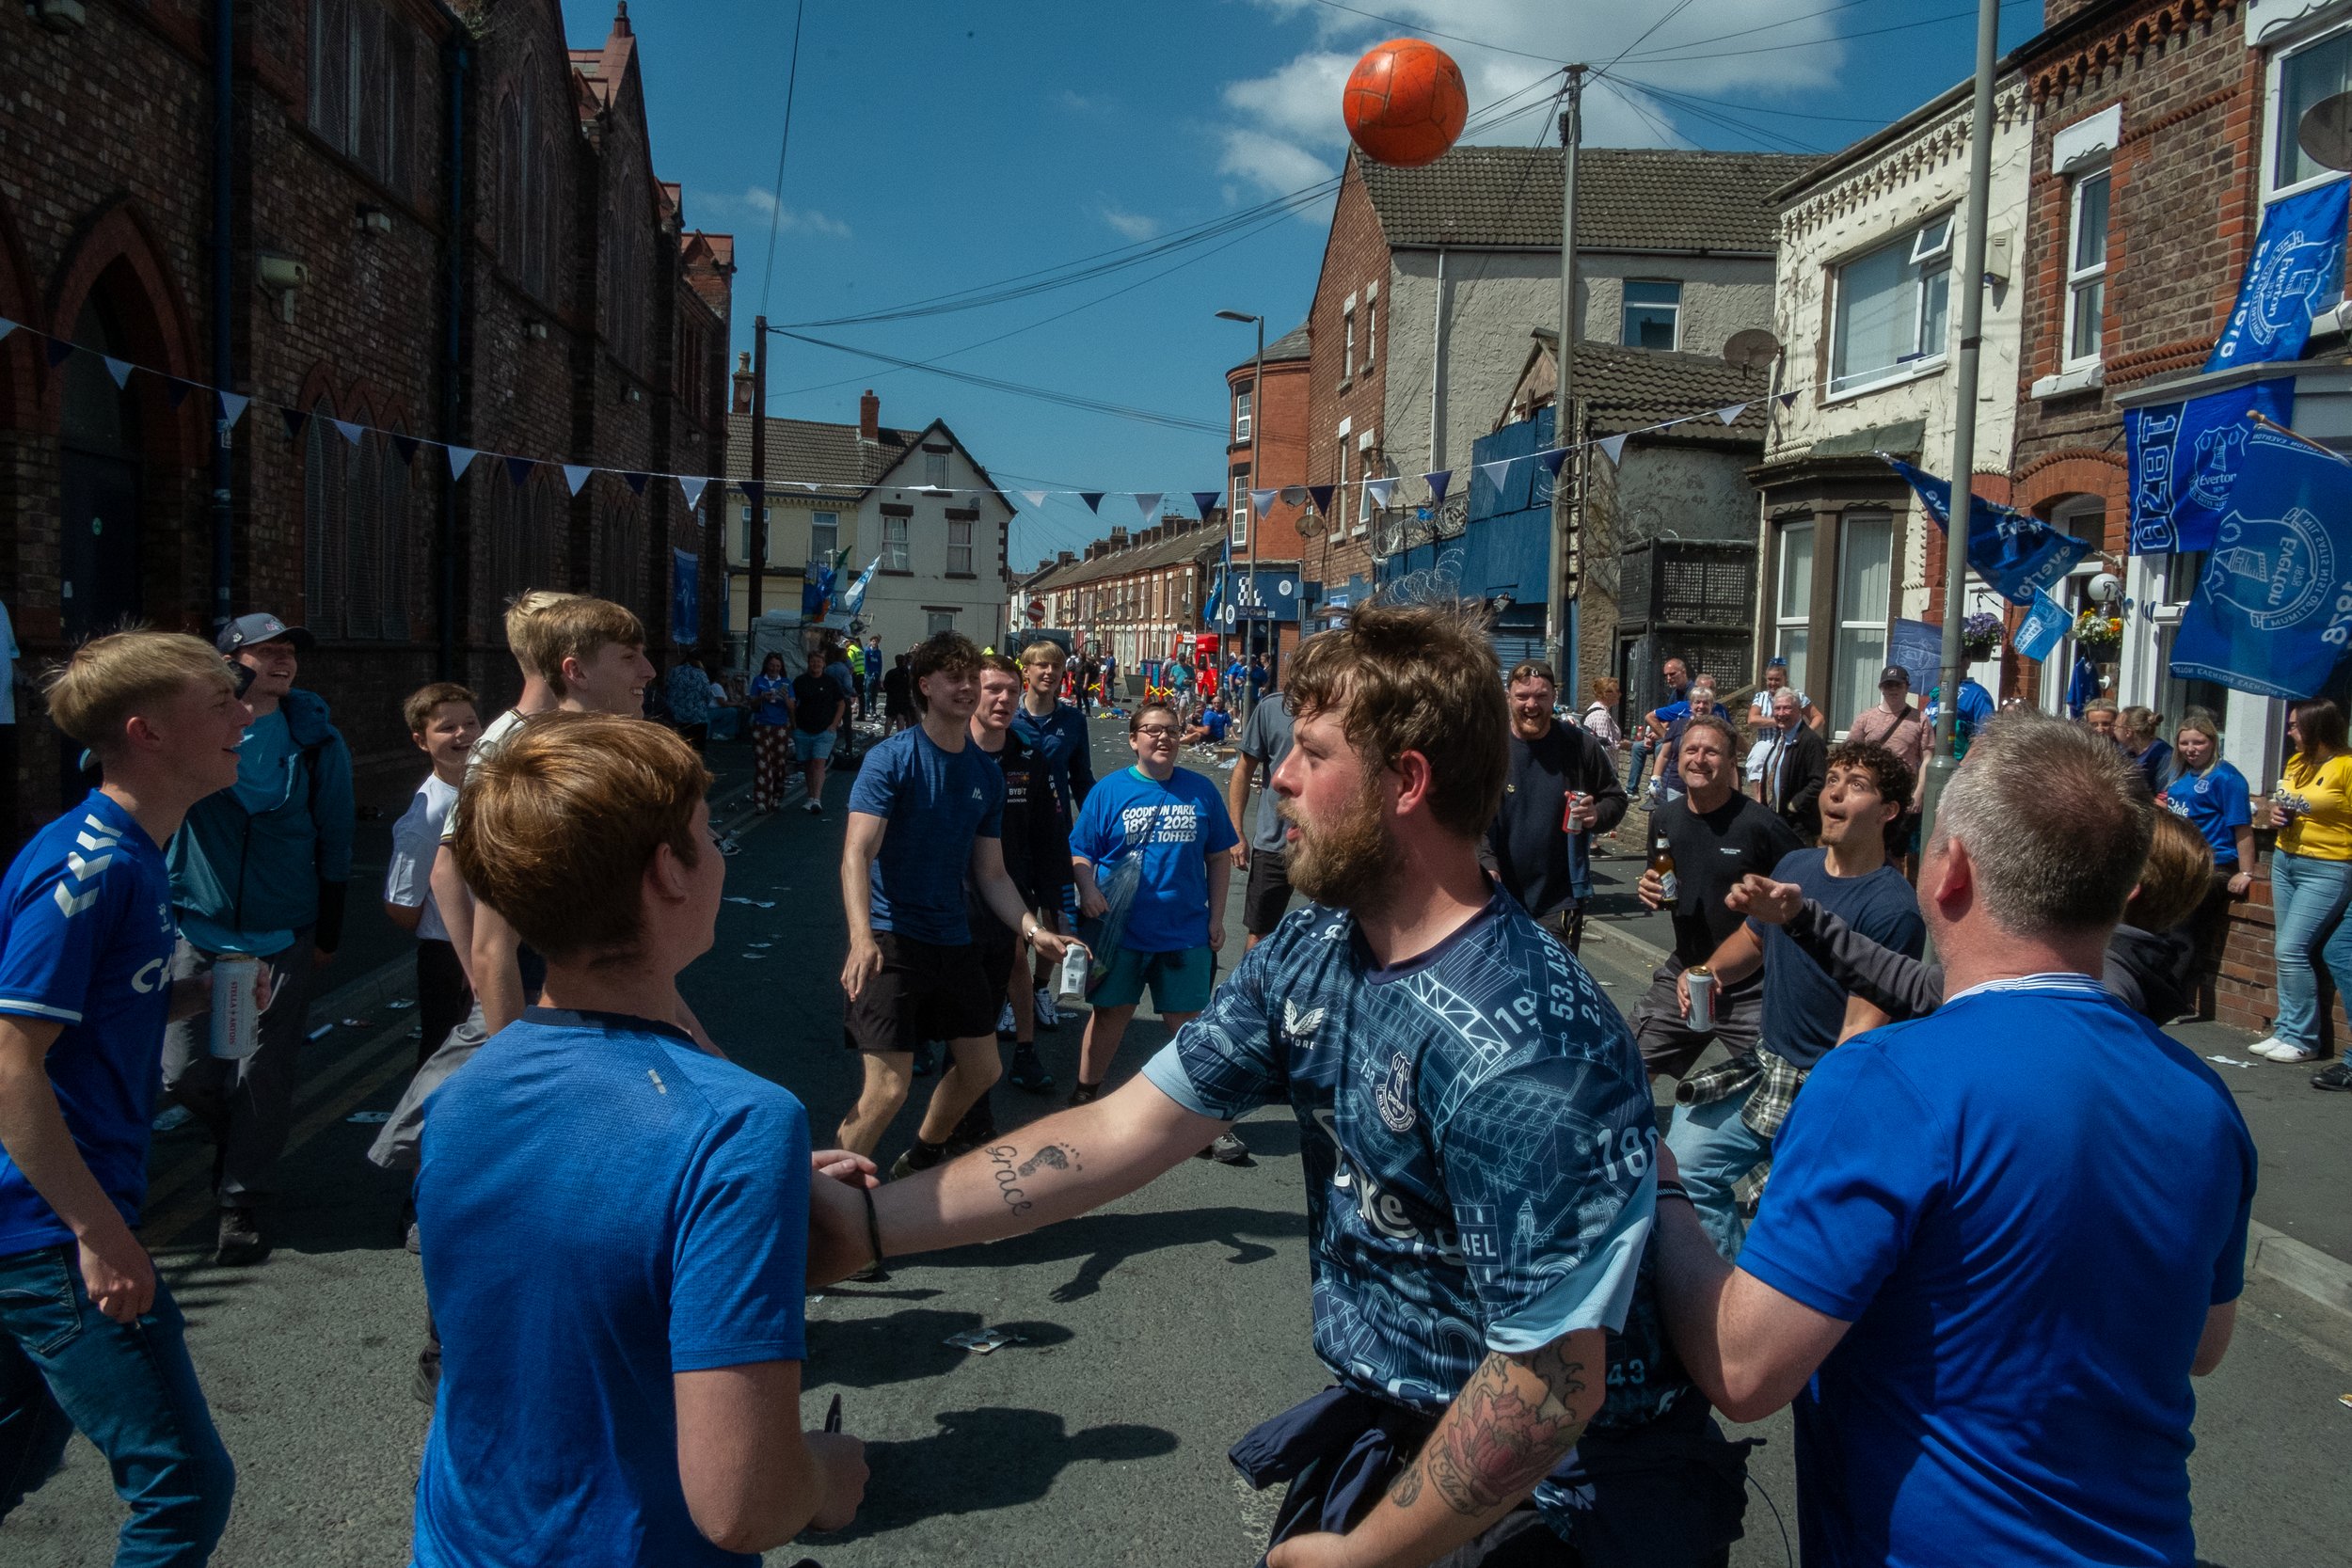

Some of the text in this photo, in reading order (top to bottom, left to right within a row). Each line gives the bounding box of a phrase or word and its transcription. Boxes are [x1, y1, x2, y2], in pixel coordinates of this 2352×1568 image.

[2267, 257, 2295, 318] Everton
[2137, 414, 2177, 549] 1878
[1163, 816, 1197, 830] 2025
[1171, 804, 1197, 816] PARK
[1157, 831, 1198, 843] TOFFEES
[985, 1145, 1032, 1217] Grace
